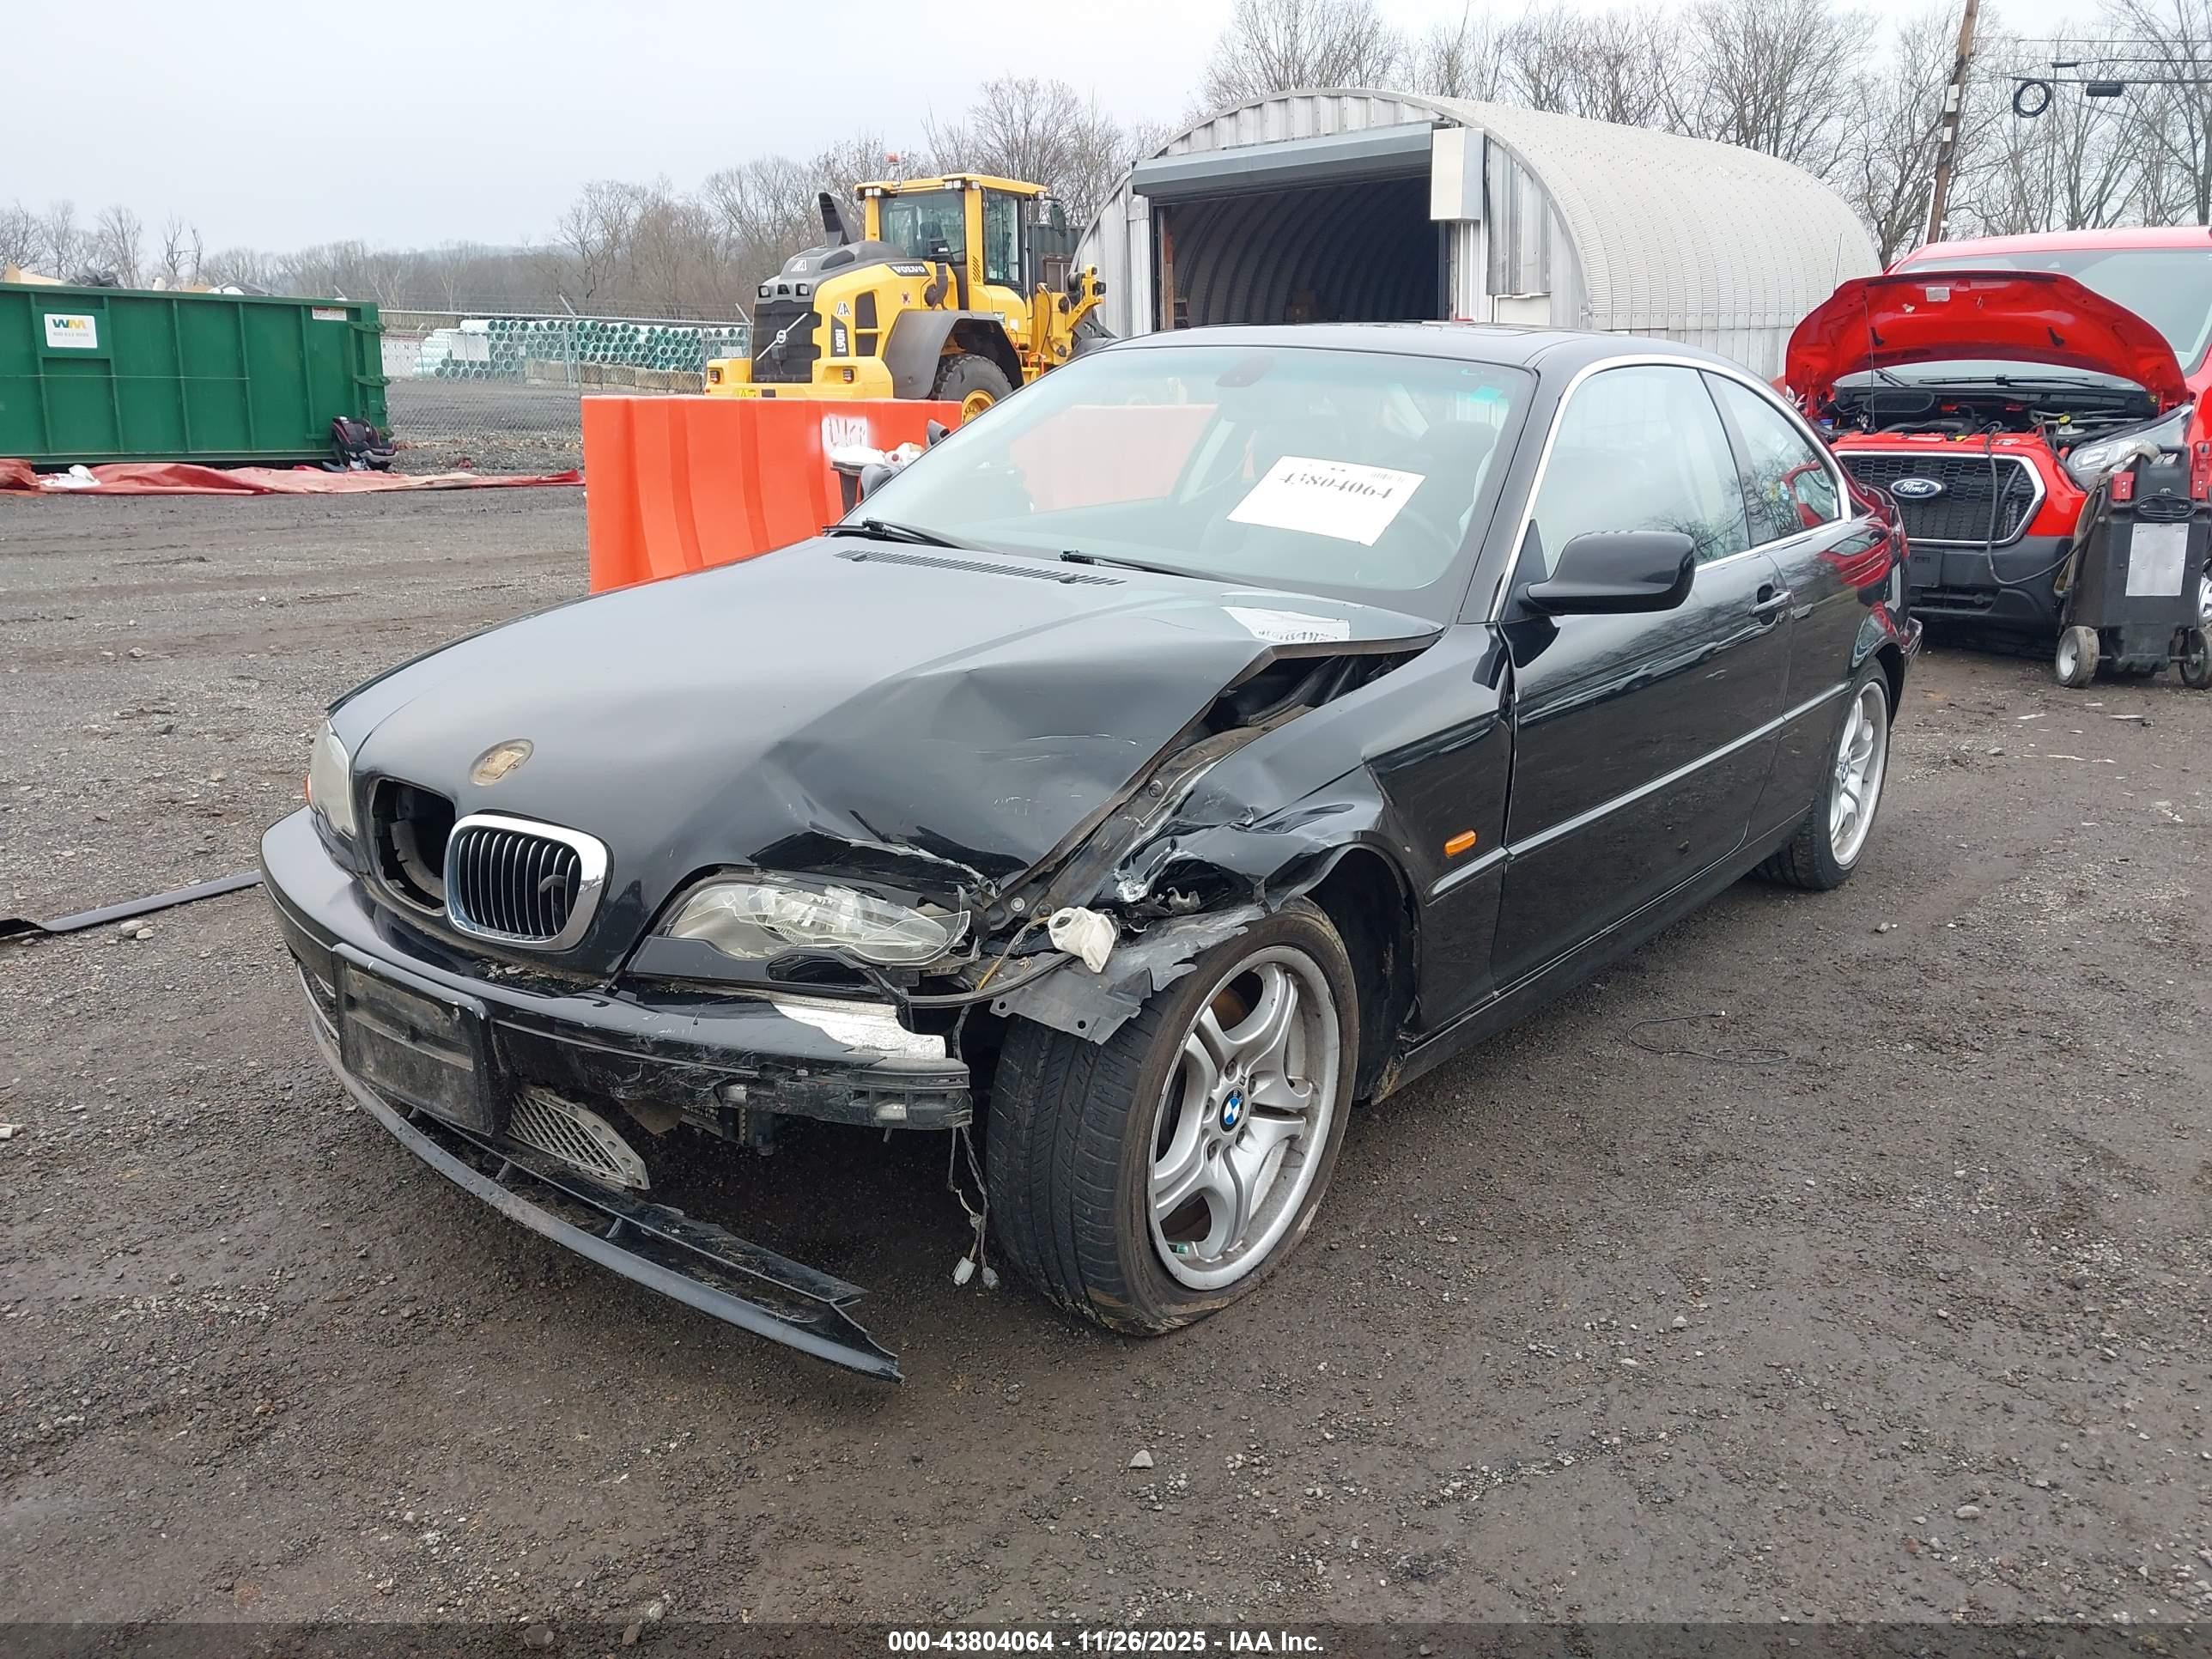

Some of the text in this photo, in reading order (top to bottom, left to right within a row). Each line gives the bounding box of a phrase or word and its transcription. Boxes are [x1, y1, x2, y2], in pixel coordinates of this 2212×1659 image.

[52, 319, 86, 330] WM
[1279, 472, 1394, 499] 43804064
[1899, 481, 1929, 493] Ford
